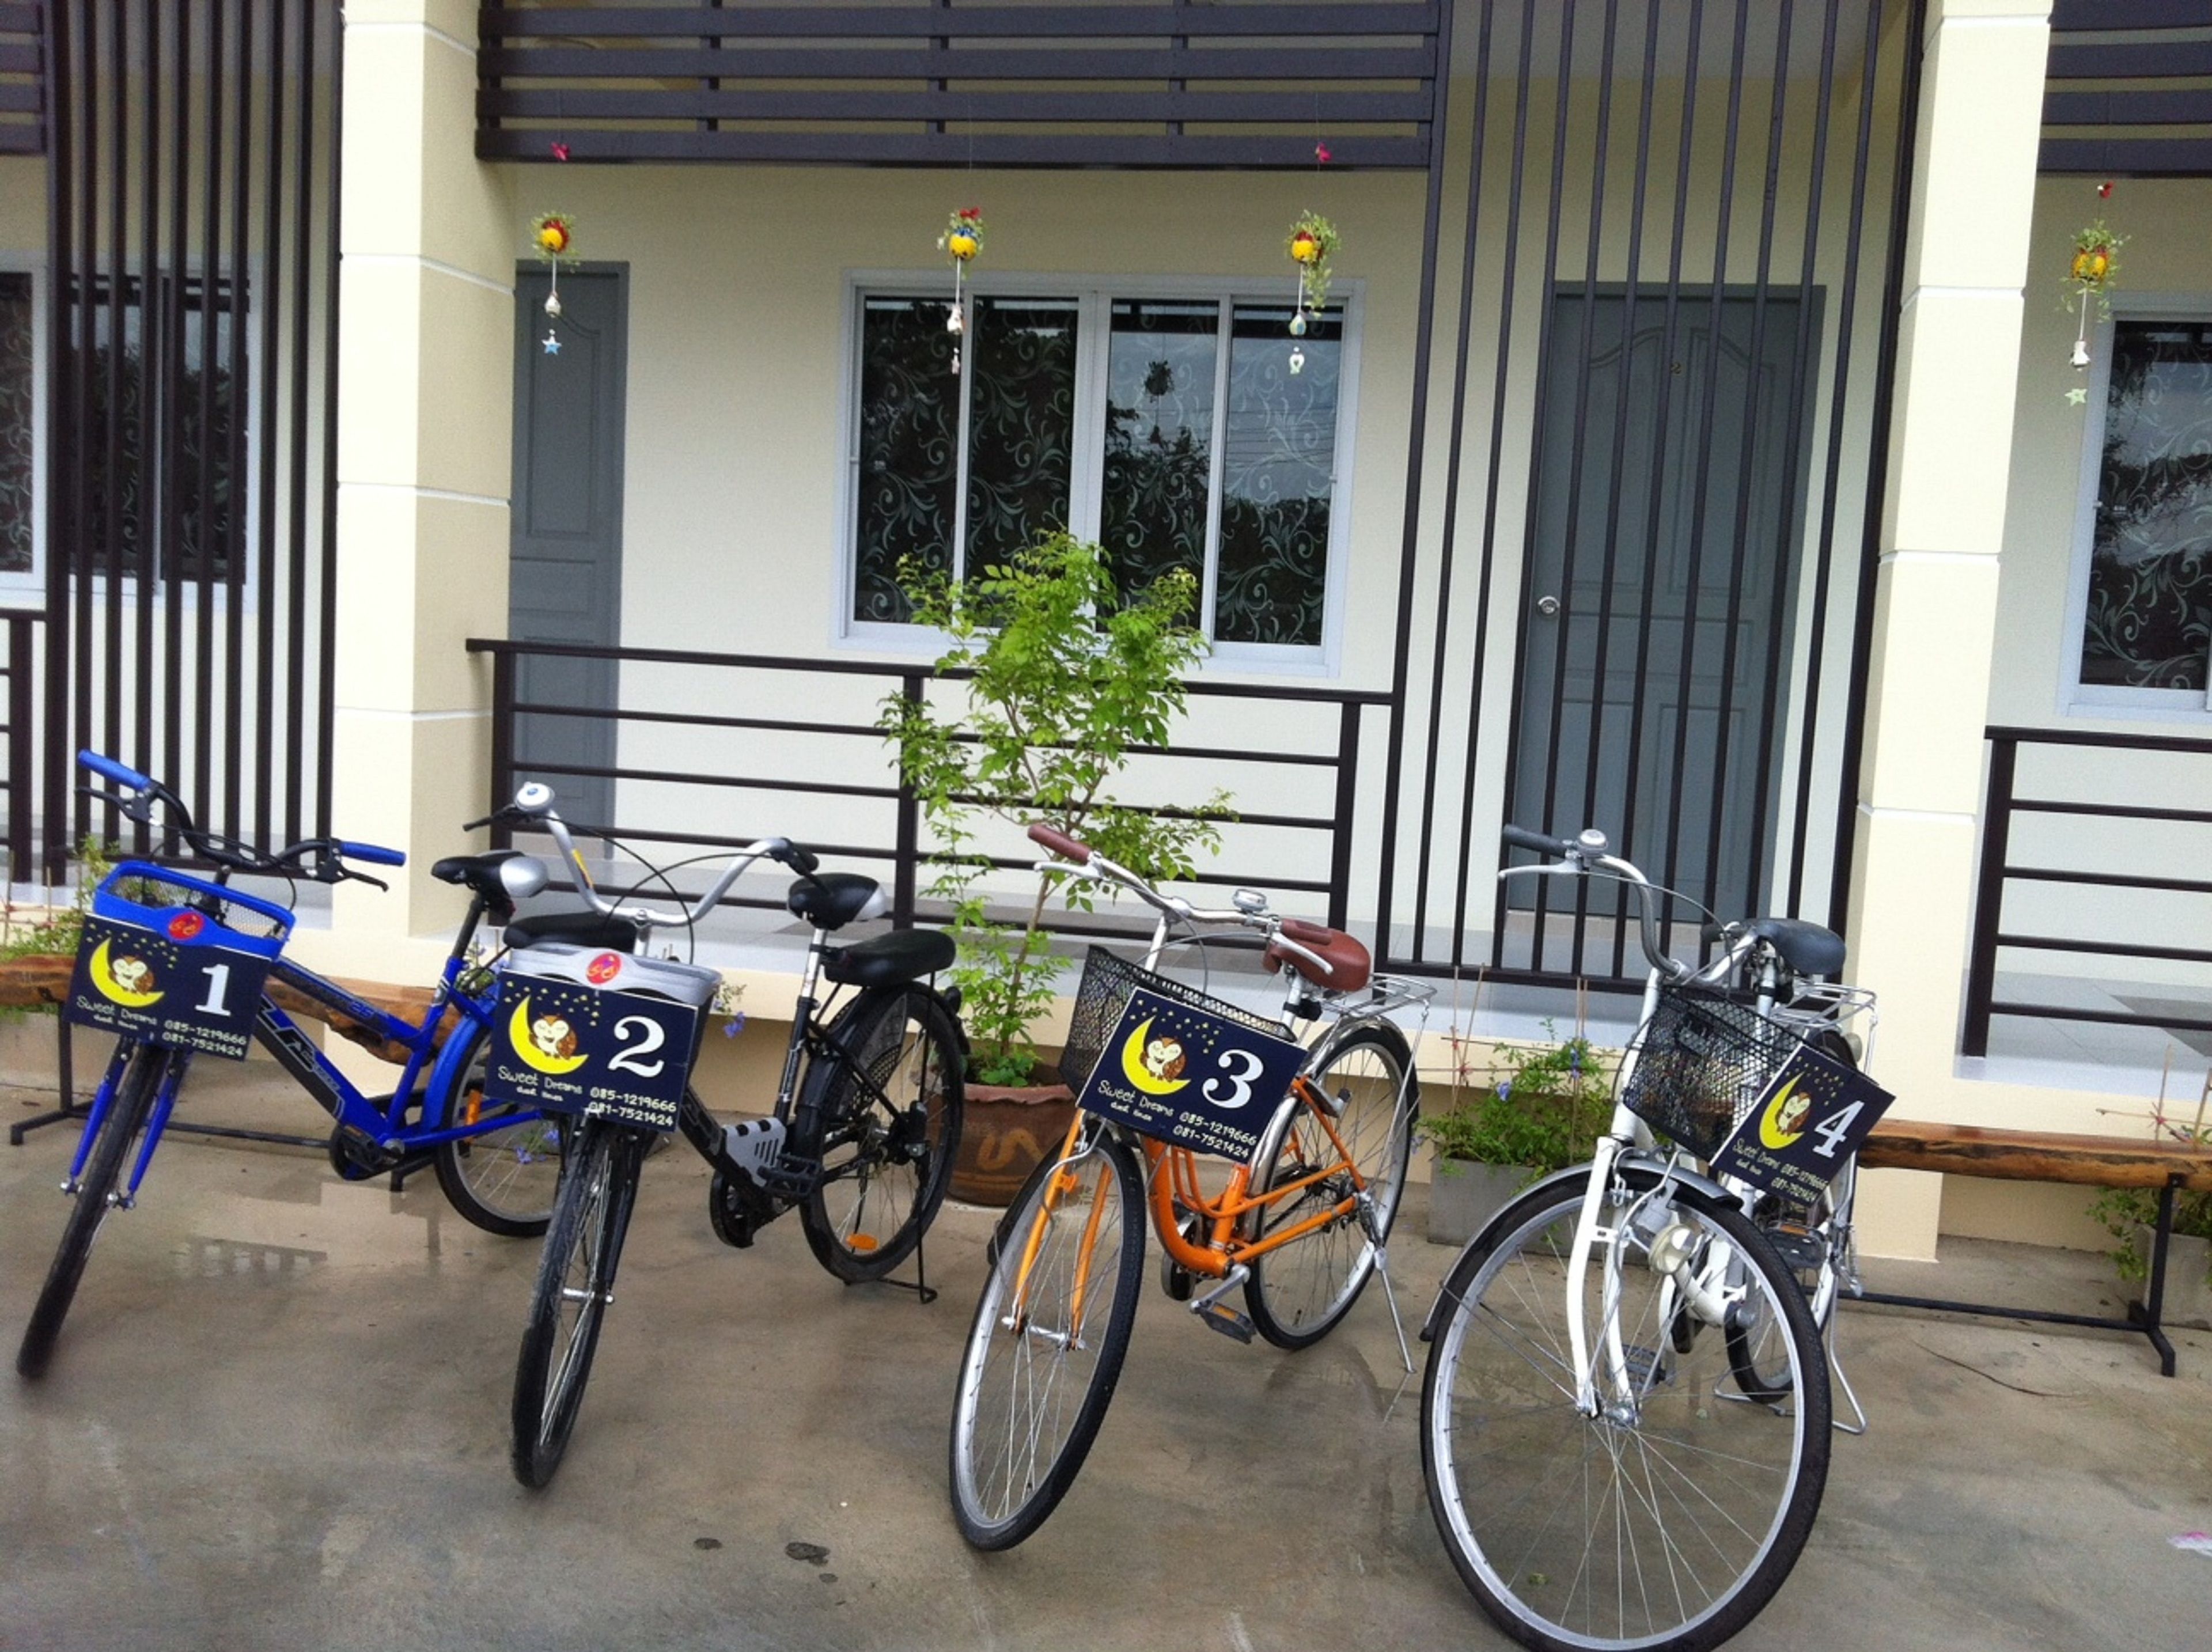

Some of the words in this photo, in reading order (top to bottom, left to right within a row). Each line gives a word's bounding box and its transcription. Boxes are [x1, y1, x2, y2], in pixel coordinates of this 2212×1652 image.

[77, 995, 115, 1016] Sweet
[195, 964, 230, 1016] 1
[608, 1016, 665, 1077] 2
[498, 1065, 539, 1086] Sweet
[544, 1077, 582, 1094] Dreams
[1202, 1049, 1264, 1109] 3
[588, 1101, 673, 1126] 081-7521424
[590, 1086, 677, 1113] 085-1219666
[1097, 1080, 1136, 1103] Sweet
[1139, 1095, 1175, 1116] Dreams
[1173, 1124, 1249, 1158] 081-7521424
[1179, 1112, 1257, 1146] 085-1219666
[1813, 1100, 1865, 1158] 4
